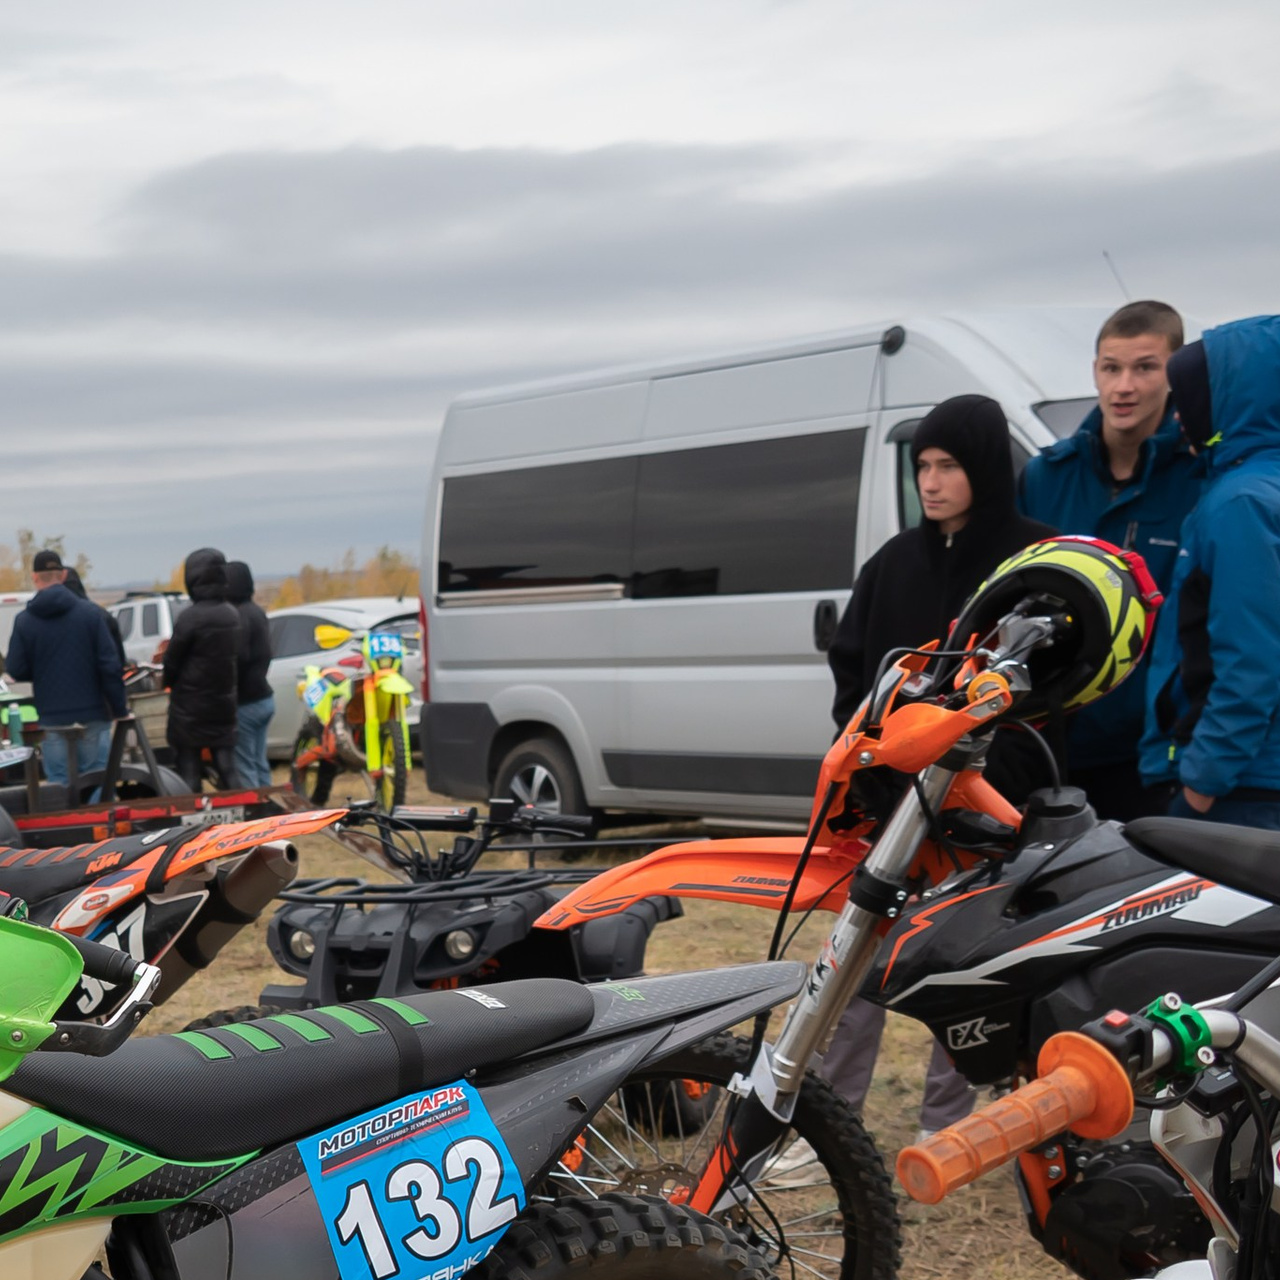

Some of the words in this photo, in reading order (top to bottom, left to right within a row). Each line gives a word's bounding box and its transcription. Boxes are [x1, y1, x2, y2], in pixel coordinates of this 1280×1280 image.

[85, 852, 124, 876] KTM
[1099, 884, 1204, 932] ZUUMAV
[318, 1086, 466, 1160] МОТОРПАРК
